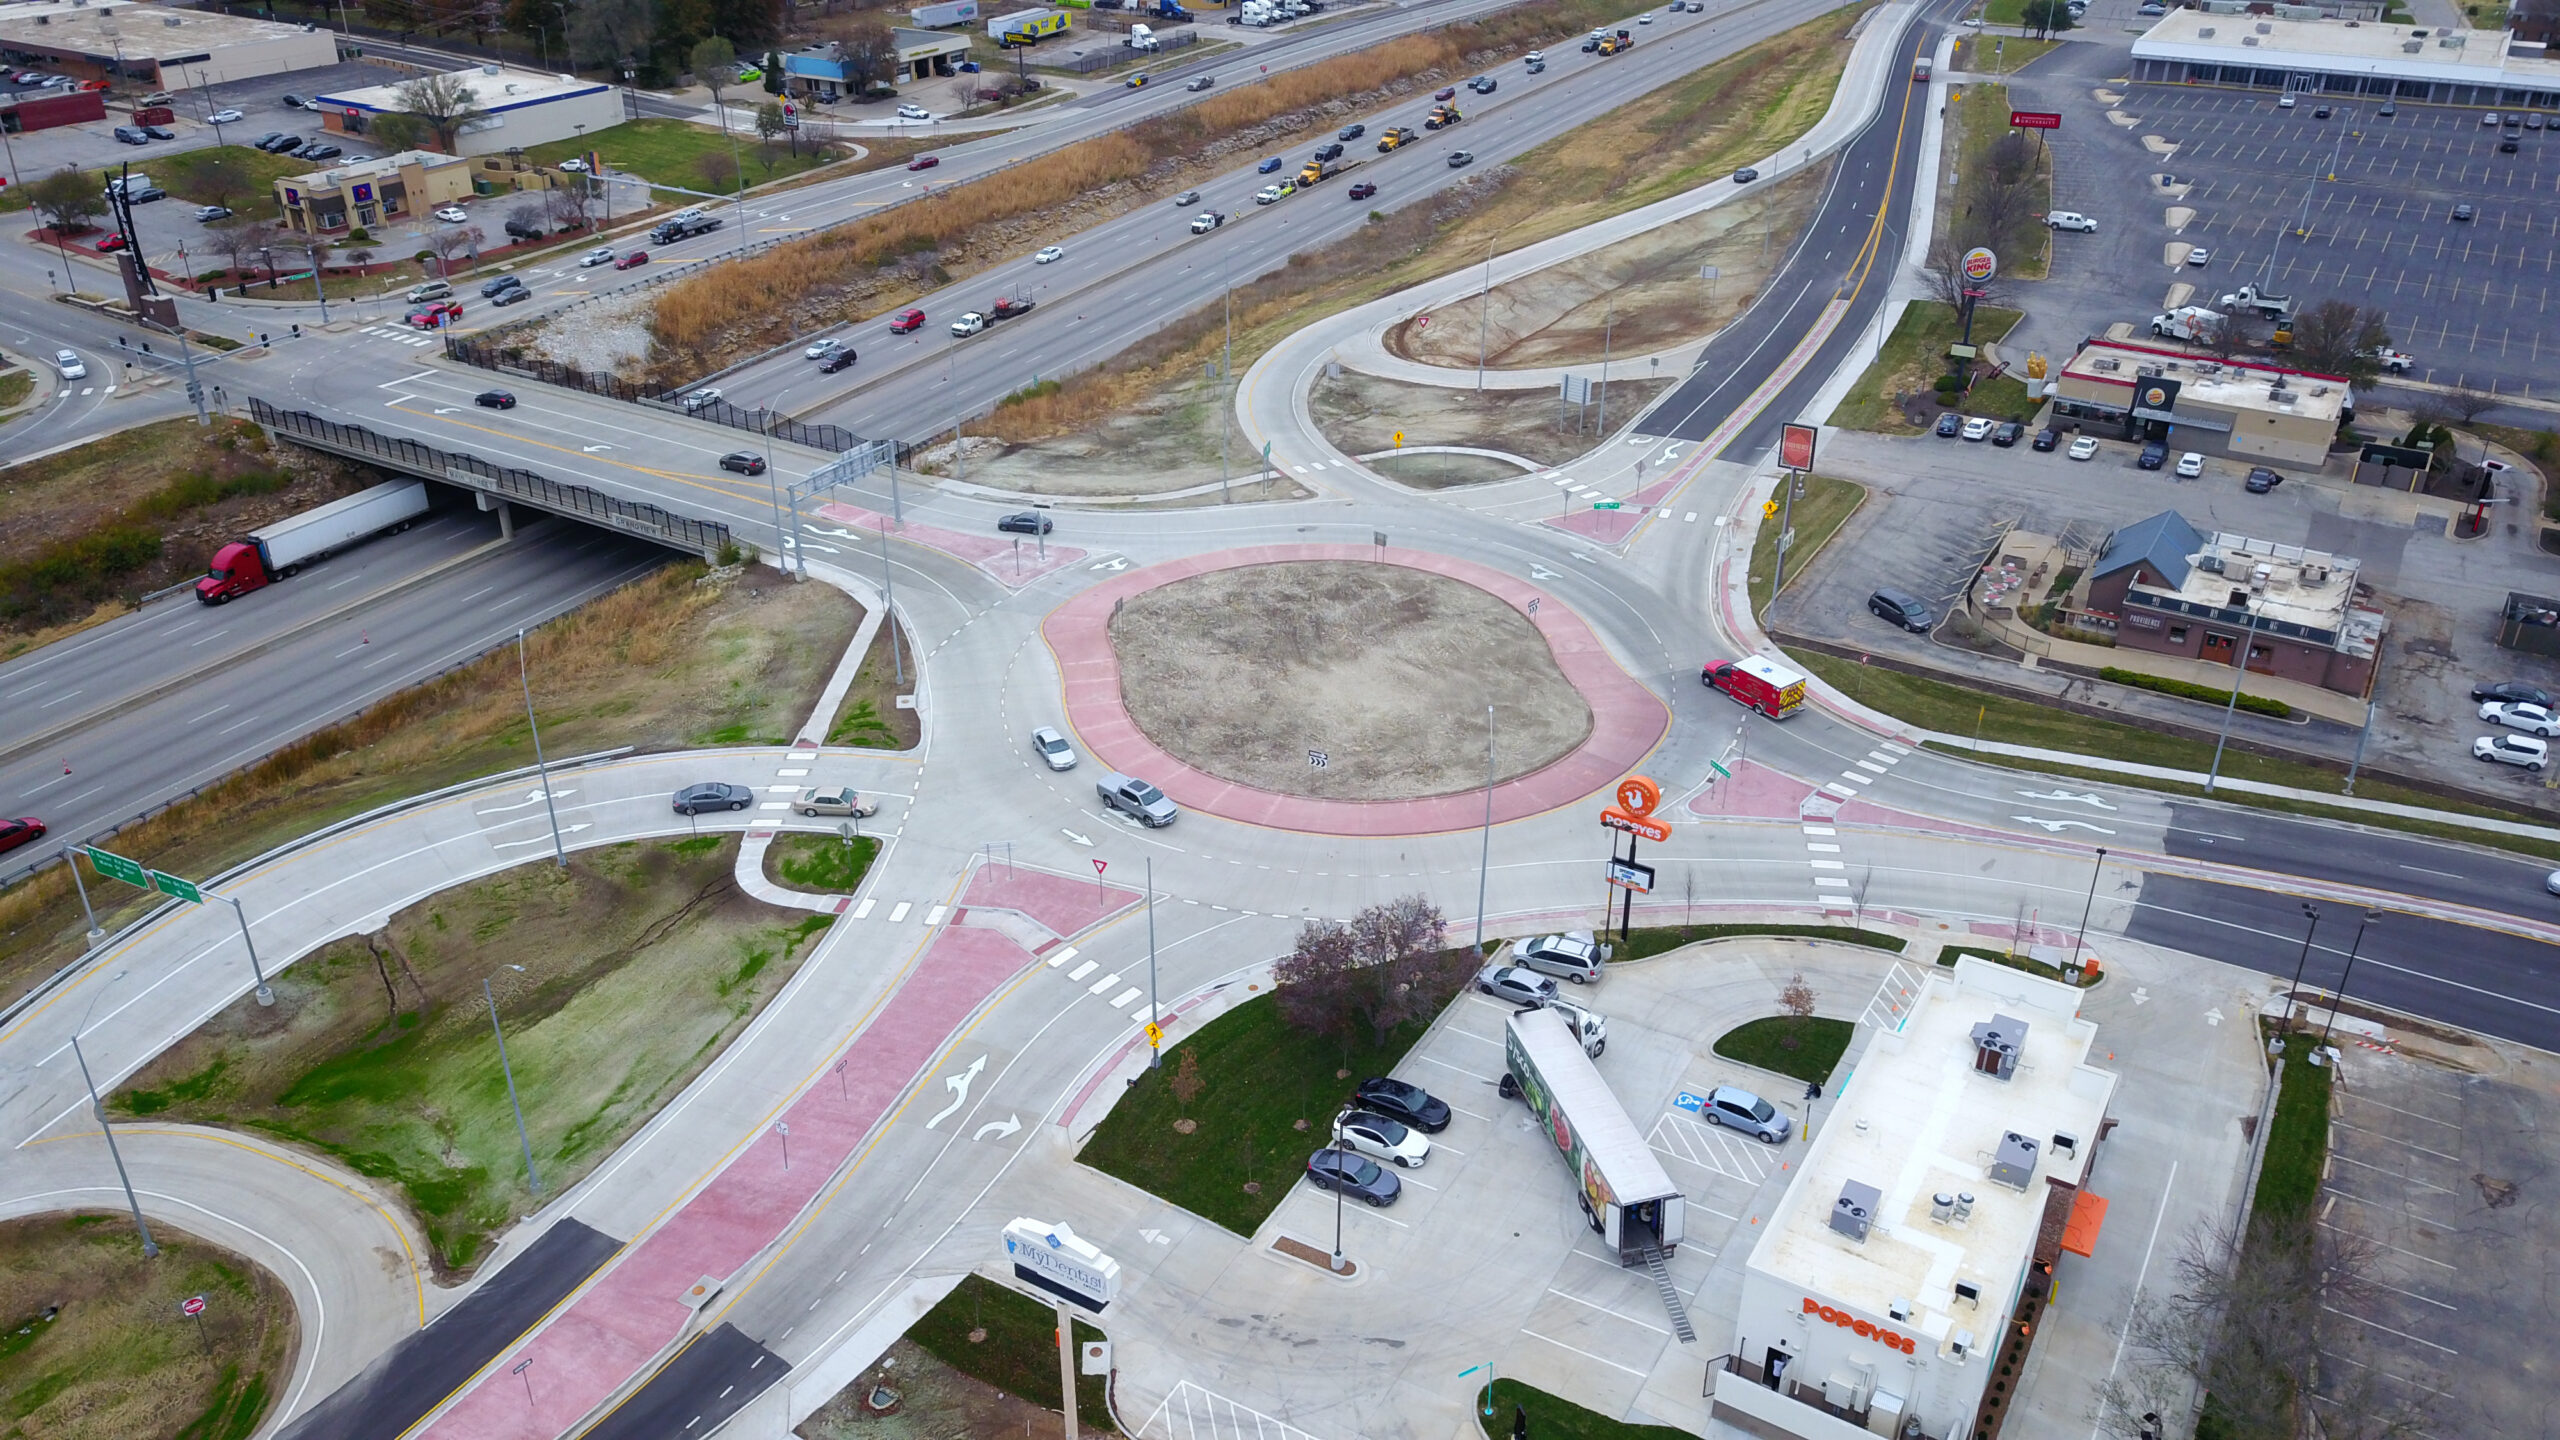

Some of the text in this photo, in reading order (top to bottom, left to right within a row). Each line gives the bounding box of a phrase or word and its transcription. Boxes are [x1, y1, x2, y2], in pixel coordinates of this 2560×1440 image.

[1966, 256, 1992, 266] BURGER
[1966, 263, 1992, 273] KING
[2129, 614, 2161, 628] PROVIDENCE
